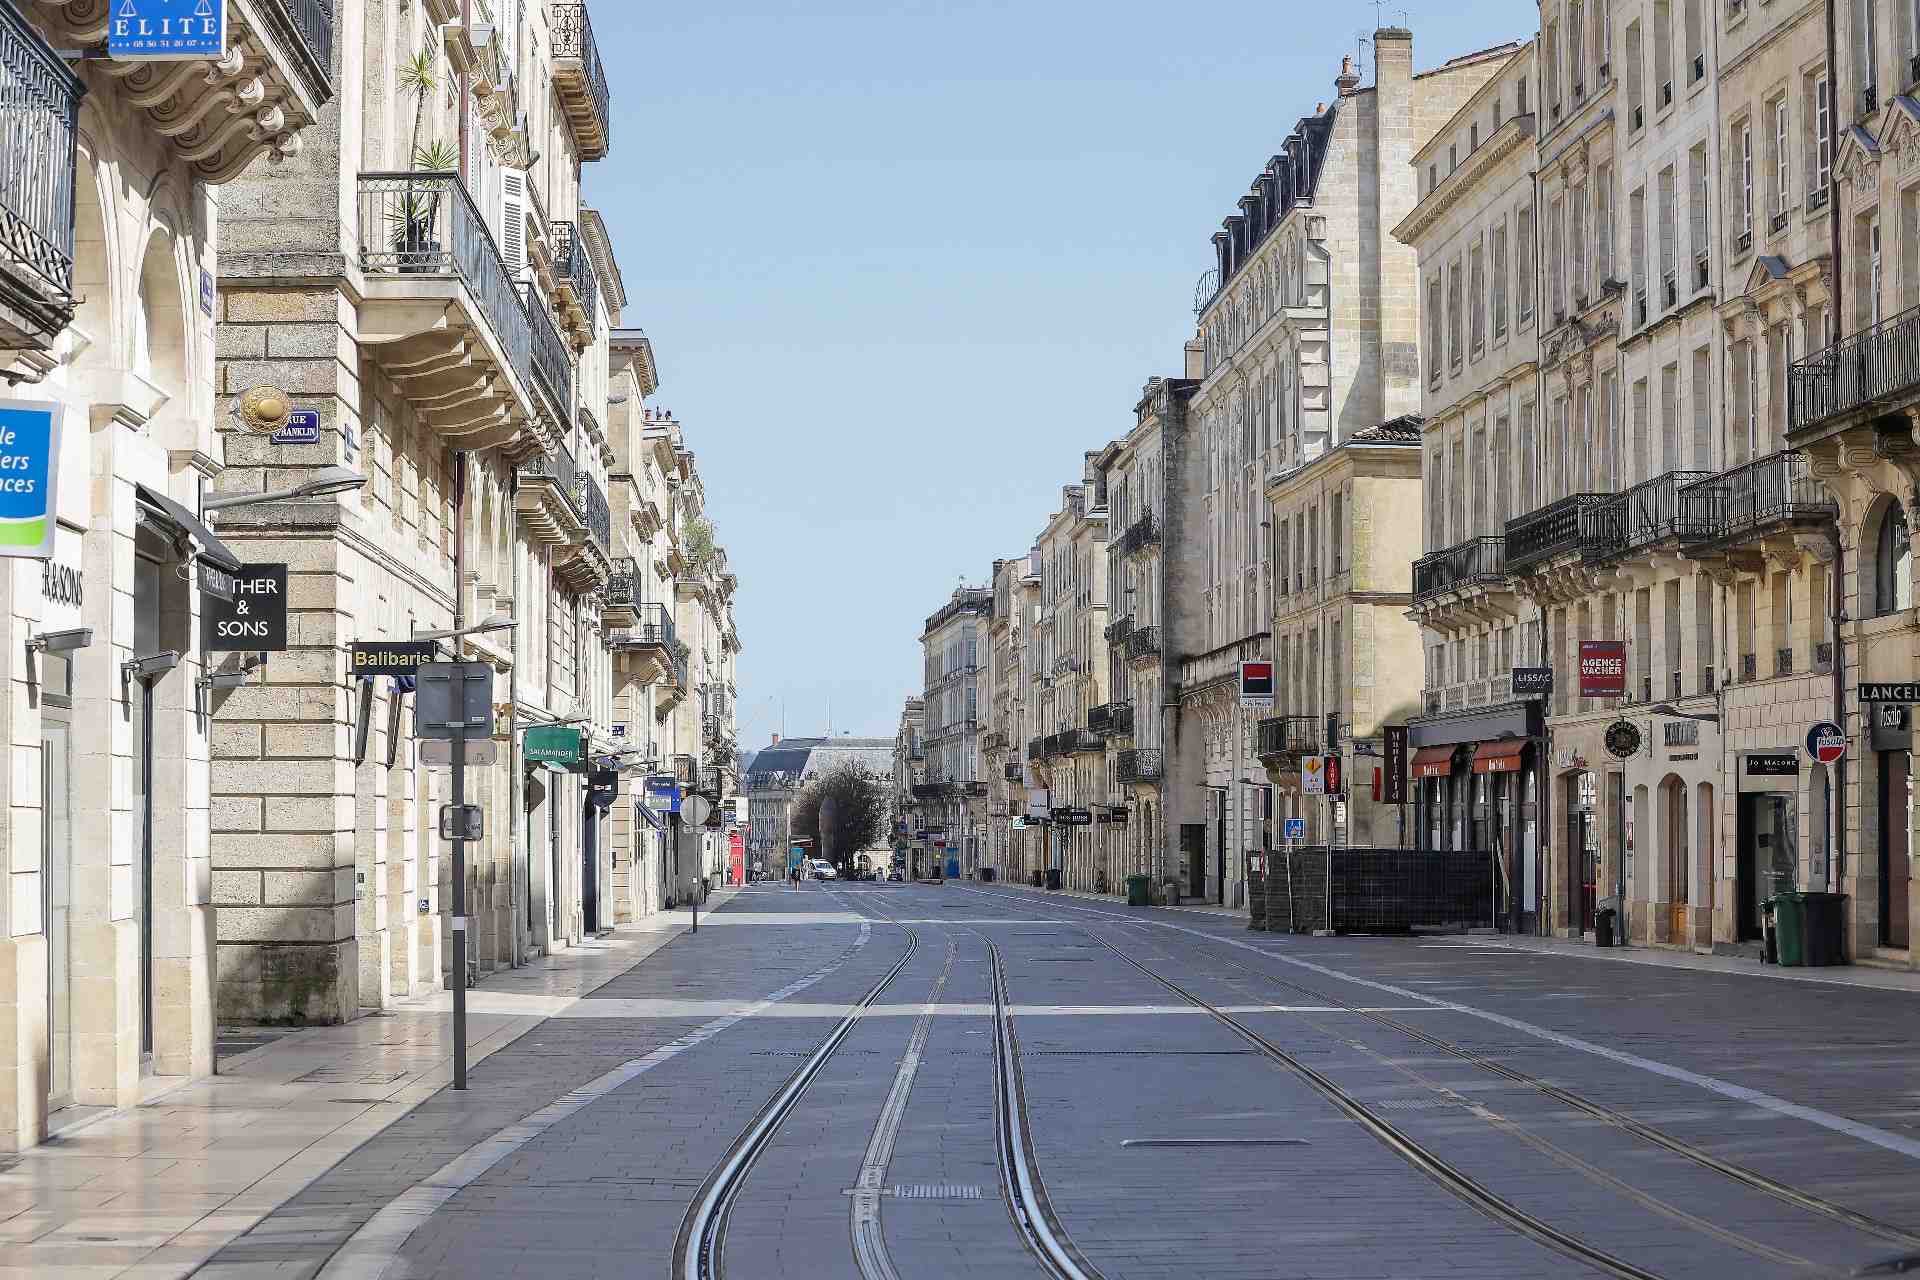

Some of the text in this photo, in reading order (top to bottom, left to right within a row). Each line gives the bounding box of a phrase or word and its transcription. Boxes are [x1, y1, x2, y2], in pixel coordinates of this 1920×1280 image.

[287, 415, 306, 424] RUE
[0, 449, 29, 470] ers
[60, 564, 82, 607] SONS
[236, 600, 249, 615] &
[217, 621, 269, 637] SONS
[355, 651, 431, 666] Balibaris
[1582, 659, 1622, 667] AGENCE
[1518, 673, 1551, 682] LISSAC
[1582, 667, 1621, 675] VACHER
[529, 748, 573, 759] SALAMANDER
